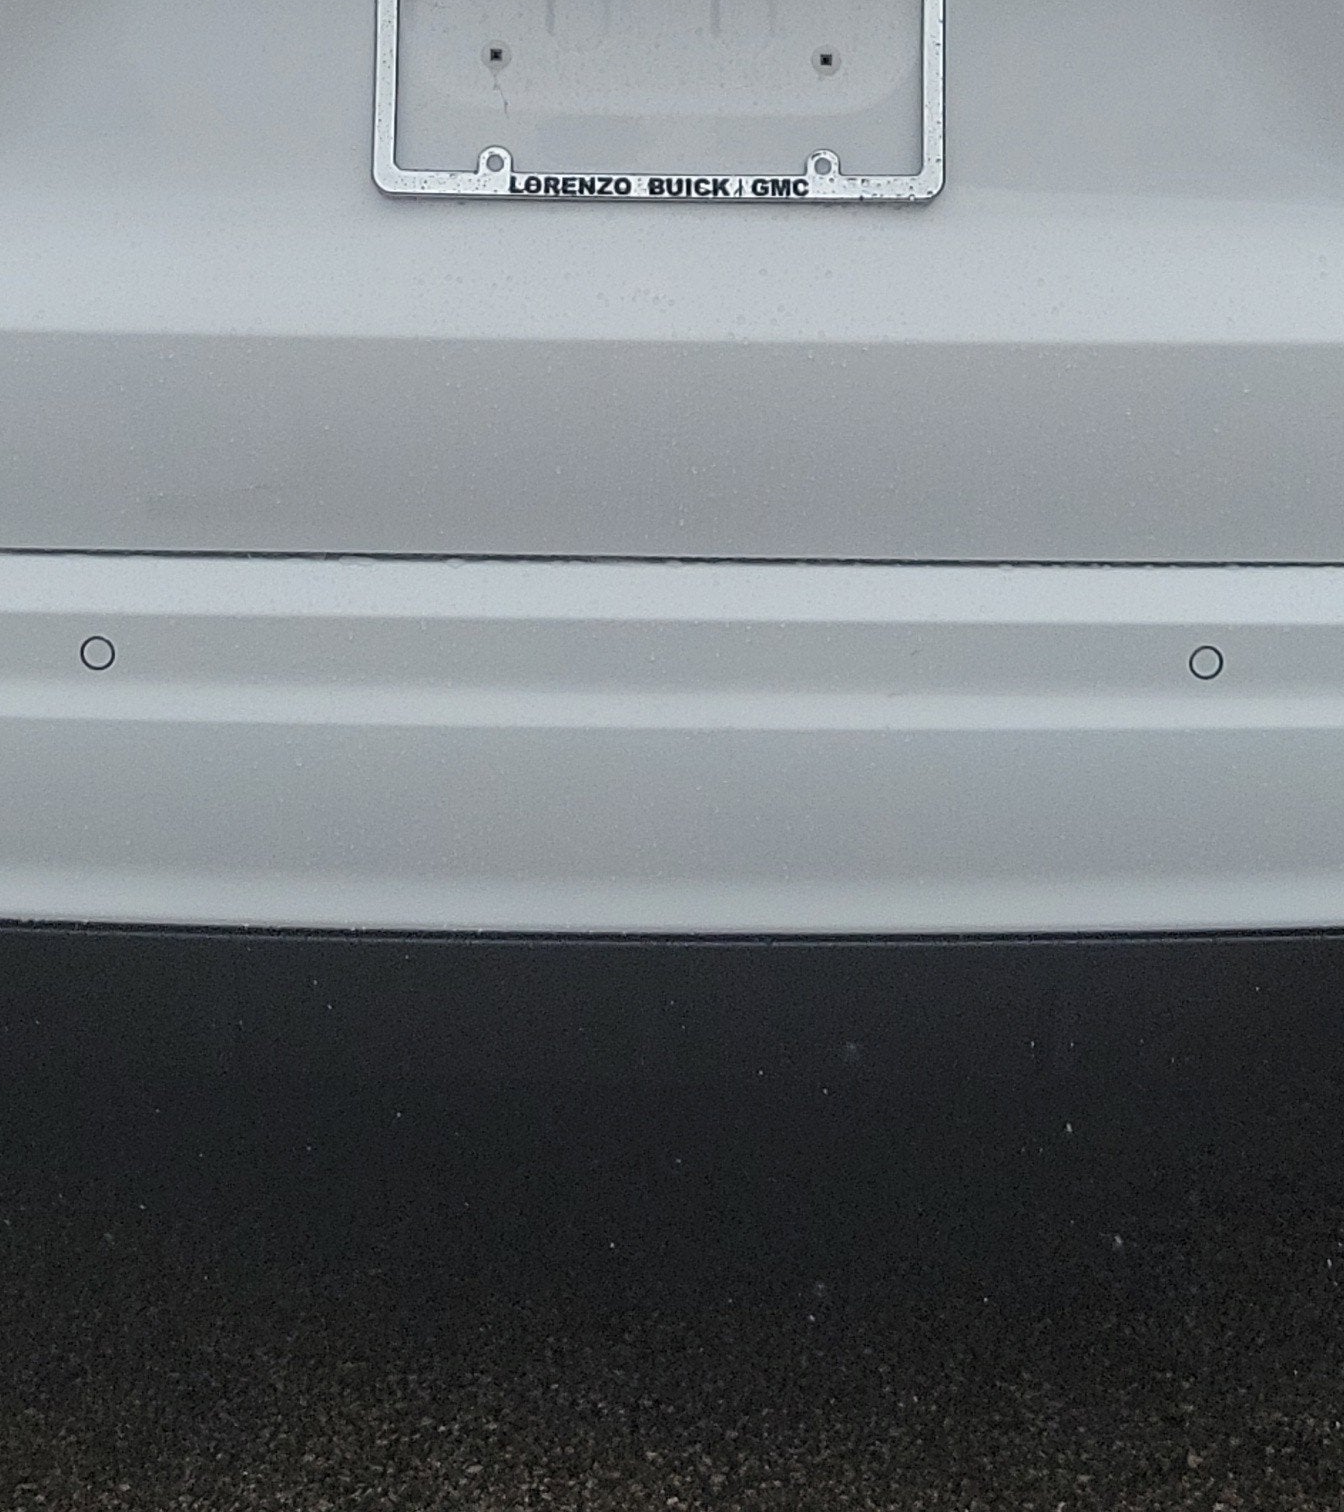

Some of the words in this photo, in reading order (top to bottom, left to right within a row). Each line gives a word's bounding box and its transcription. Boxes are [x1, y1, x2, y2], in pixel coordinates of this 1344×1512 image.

[508, 175, 632, 196] LORENZO
[647, 176, 731, 197] BUICK
[750, 177, 810, 198] GMC
